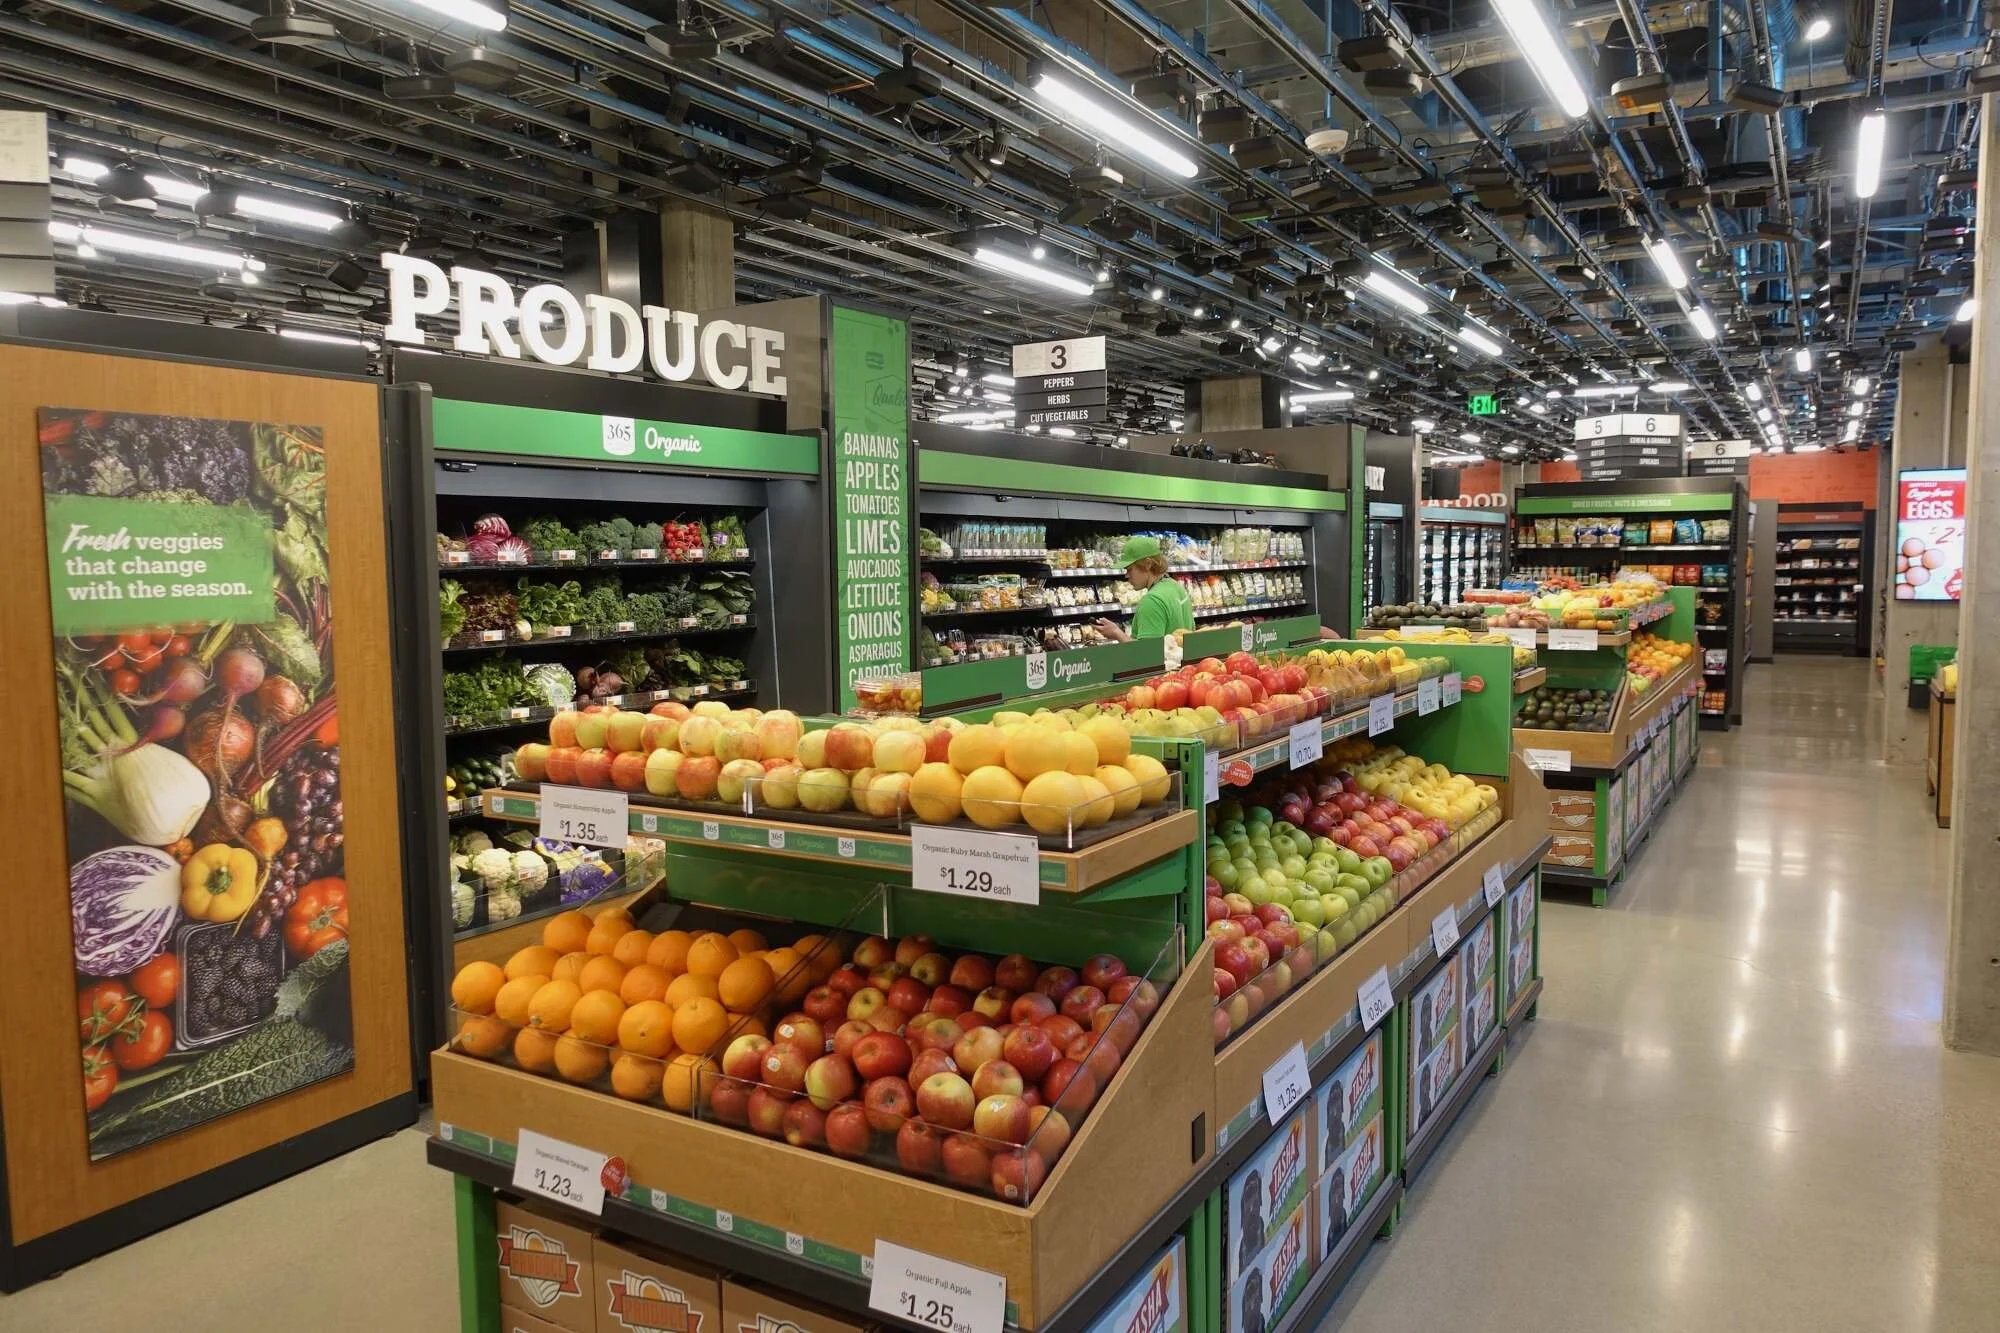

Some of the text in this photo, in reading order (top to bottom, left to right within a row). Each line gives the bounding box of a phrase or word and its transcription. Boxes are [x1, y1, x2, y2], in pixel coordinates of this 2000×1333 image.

[381, 252, 788, 396] PRODUCE
[1050, 344, 1067, 369] 3
[1044, 377, 1074, 389] PEPPERS
[1047, 394, 1070, 405] HERBS
[1030, 410, 1089, 424] CUT VEGETABLES
[1595, 420, 1602, 434] 5
[1646, 418, 1656, 432] 6
[607, 425, 702, 456] 365 Organic
[844, 432, 899, 460] BANANAS
[1716, 444, 1726, 456] 6
[846, 460, 900, 491] APPLES
[846, 494, 900, 516] TOMATOES
[1906, 500, 1954, 520] EGGS
[62, 524, 224, 554] Fresh veggies
[846, 519, 901, 555] LIMES
[66, 553, 208, 577] that change
[847, 559, 901, 580] AVOCADOS
[68, 580, 253, 601] with the season.
[847, 582, 902, 609] LETTUCE
[848, 611, 902, 641] ONIONS
[1256, 628, 1278, 647] Organic
[849, 641, 902, 664] ASPARAGUS
[1028, 660, 1044, 677] 365
[1054, 657, 1092, 682] Organic
[560, 820, 596, 841] $1.35
[922, 844, 1030, 863] Organic Ruby Marsh Grapefruit
[940, 866, 1012, 896] $1.29 each
[1352, 1054, 1371, 1104] TASHA
[1278, 1083, 1297, 1110] $1.25
[1273, 1132, 1296, 1194] TASHA
[1353, 1137, 1371, 1189] TASHA
[534, 1168, 572, 1198] $1.23
[1274, 1225, 1296, 1287] TASHA
[906, 1268, 972, 1296] Organic Fuji Apple
[900, 1291, 954, 1329] $1.25
